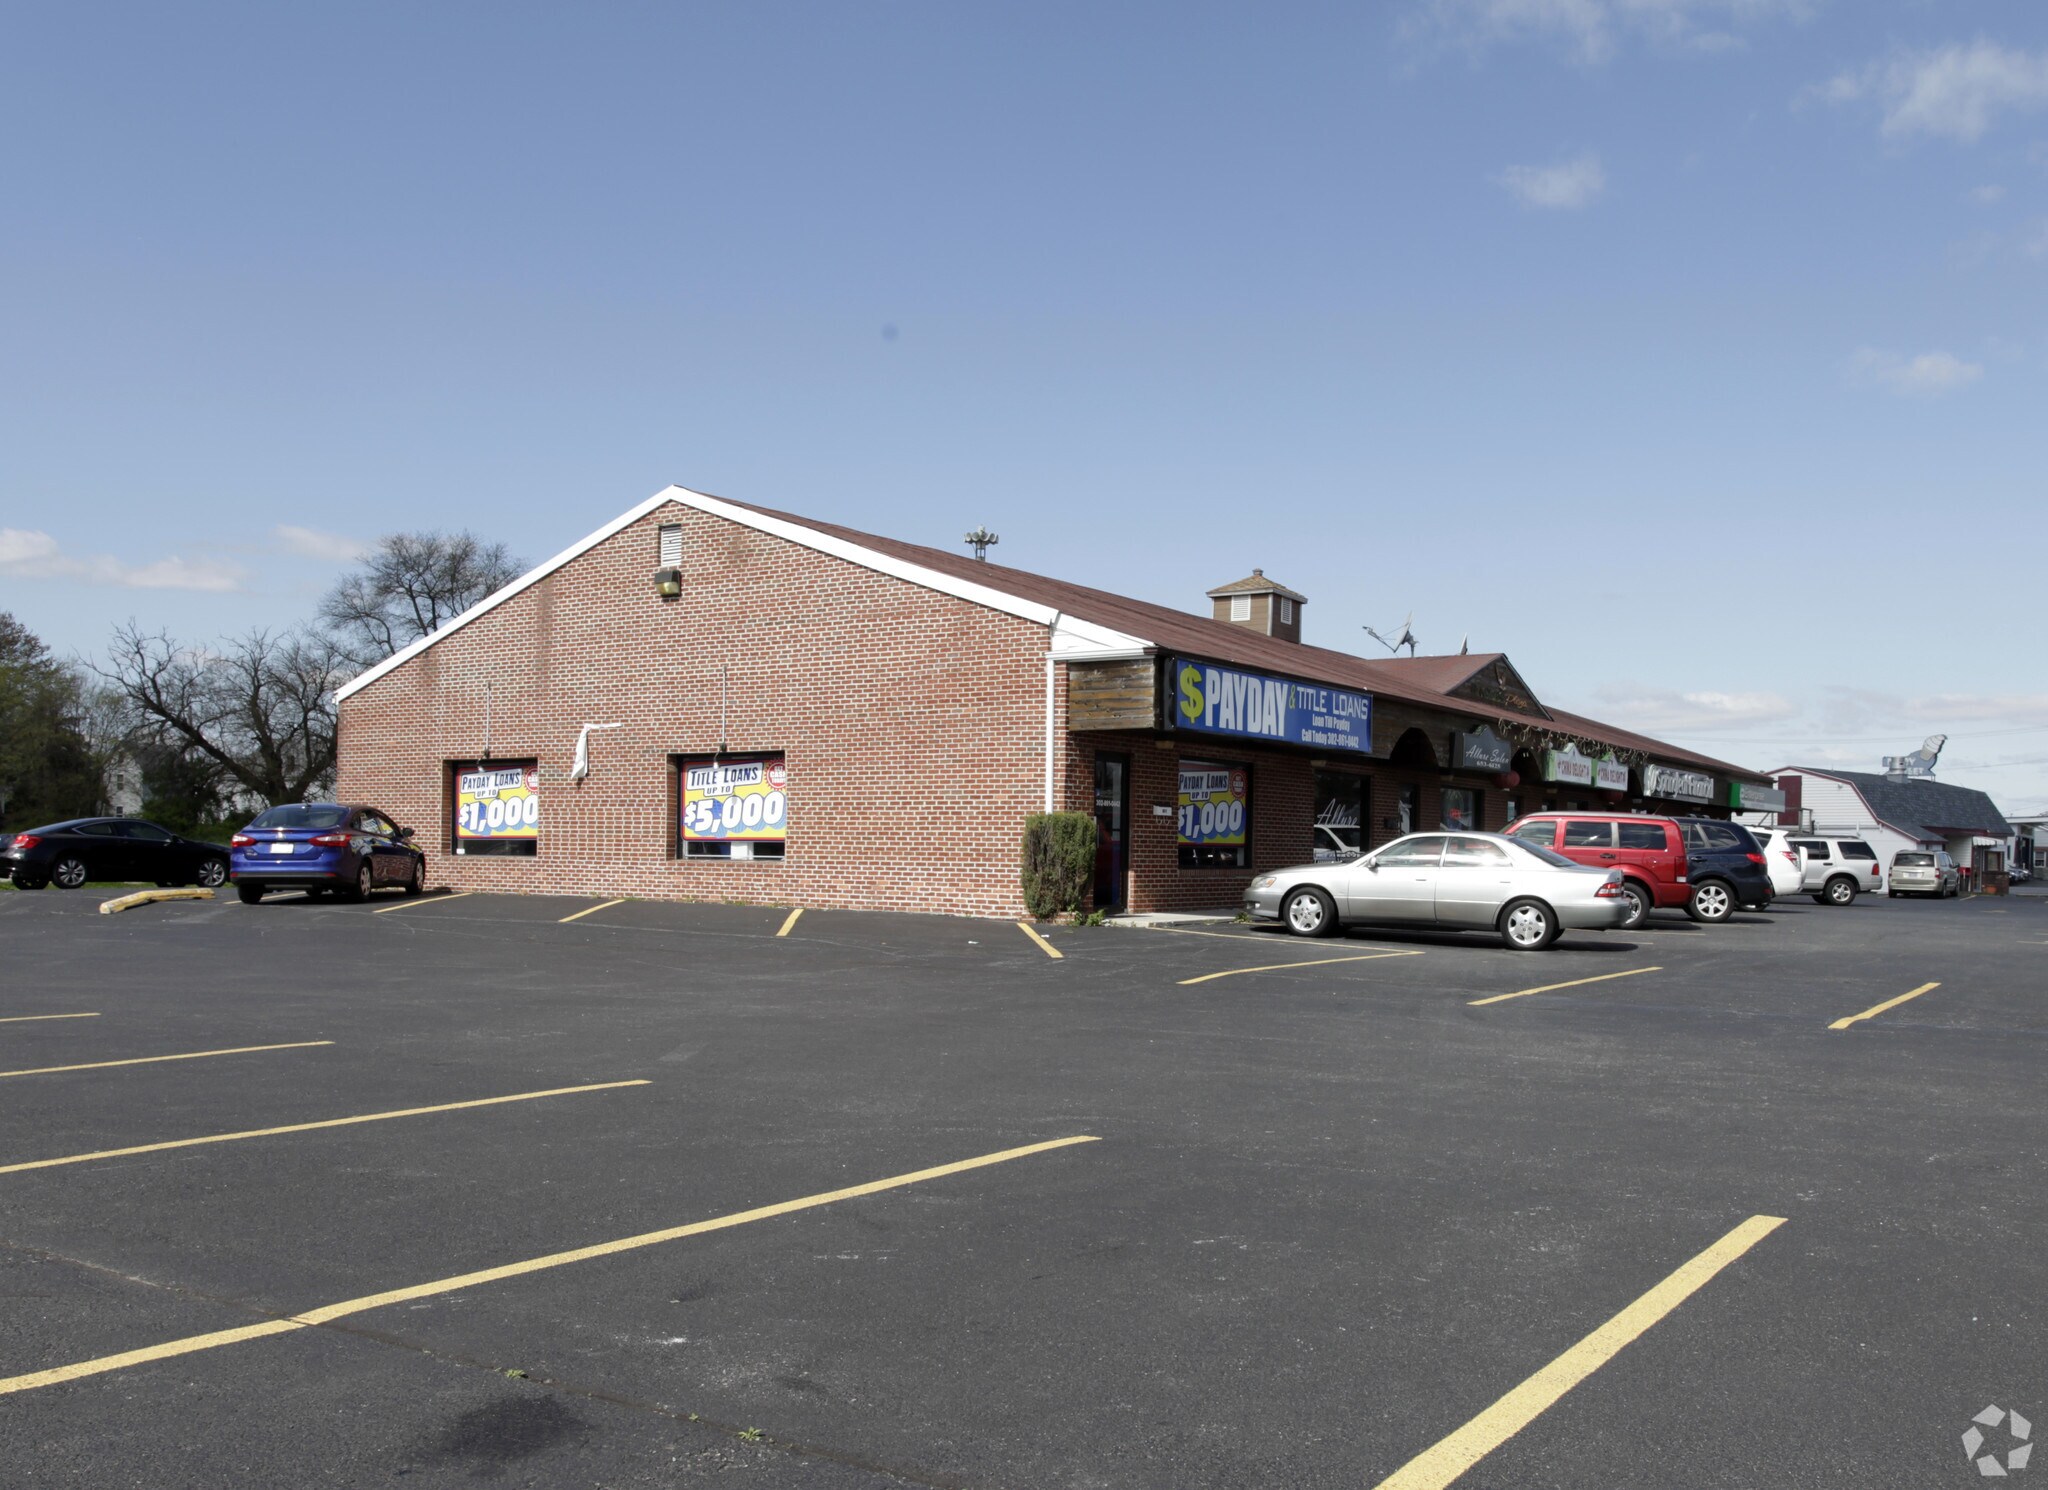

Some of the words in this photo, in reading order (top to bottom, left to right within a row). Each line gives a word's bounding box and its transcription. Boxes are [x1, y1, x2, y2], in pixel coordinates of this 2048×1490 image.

[1289, 684, 1296, 709] &
[1297, 686, 1328, 713] TITLE
[1332, 693, 1368, 720] LOANS
[1333, 716, 1350, 732] Payday
[1301, 728, 1312, 742] Call
[1312, 730, 1327, 745] Today
[1465, 744, 1488, 760] Allure
[1489, 749, 1509, 764] Salon
[707, 786, 717, 794] UP
[721, 785, 730, 793] TO
[1201, 791, 1209, 799] TO
[459, 794, 538, 832] $1,000
[684, 791, 785, 833] $5,000
[1316, 798, 1358, 826] Allure
